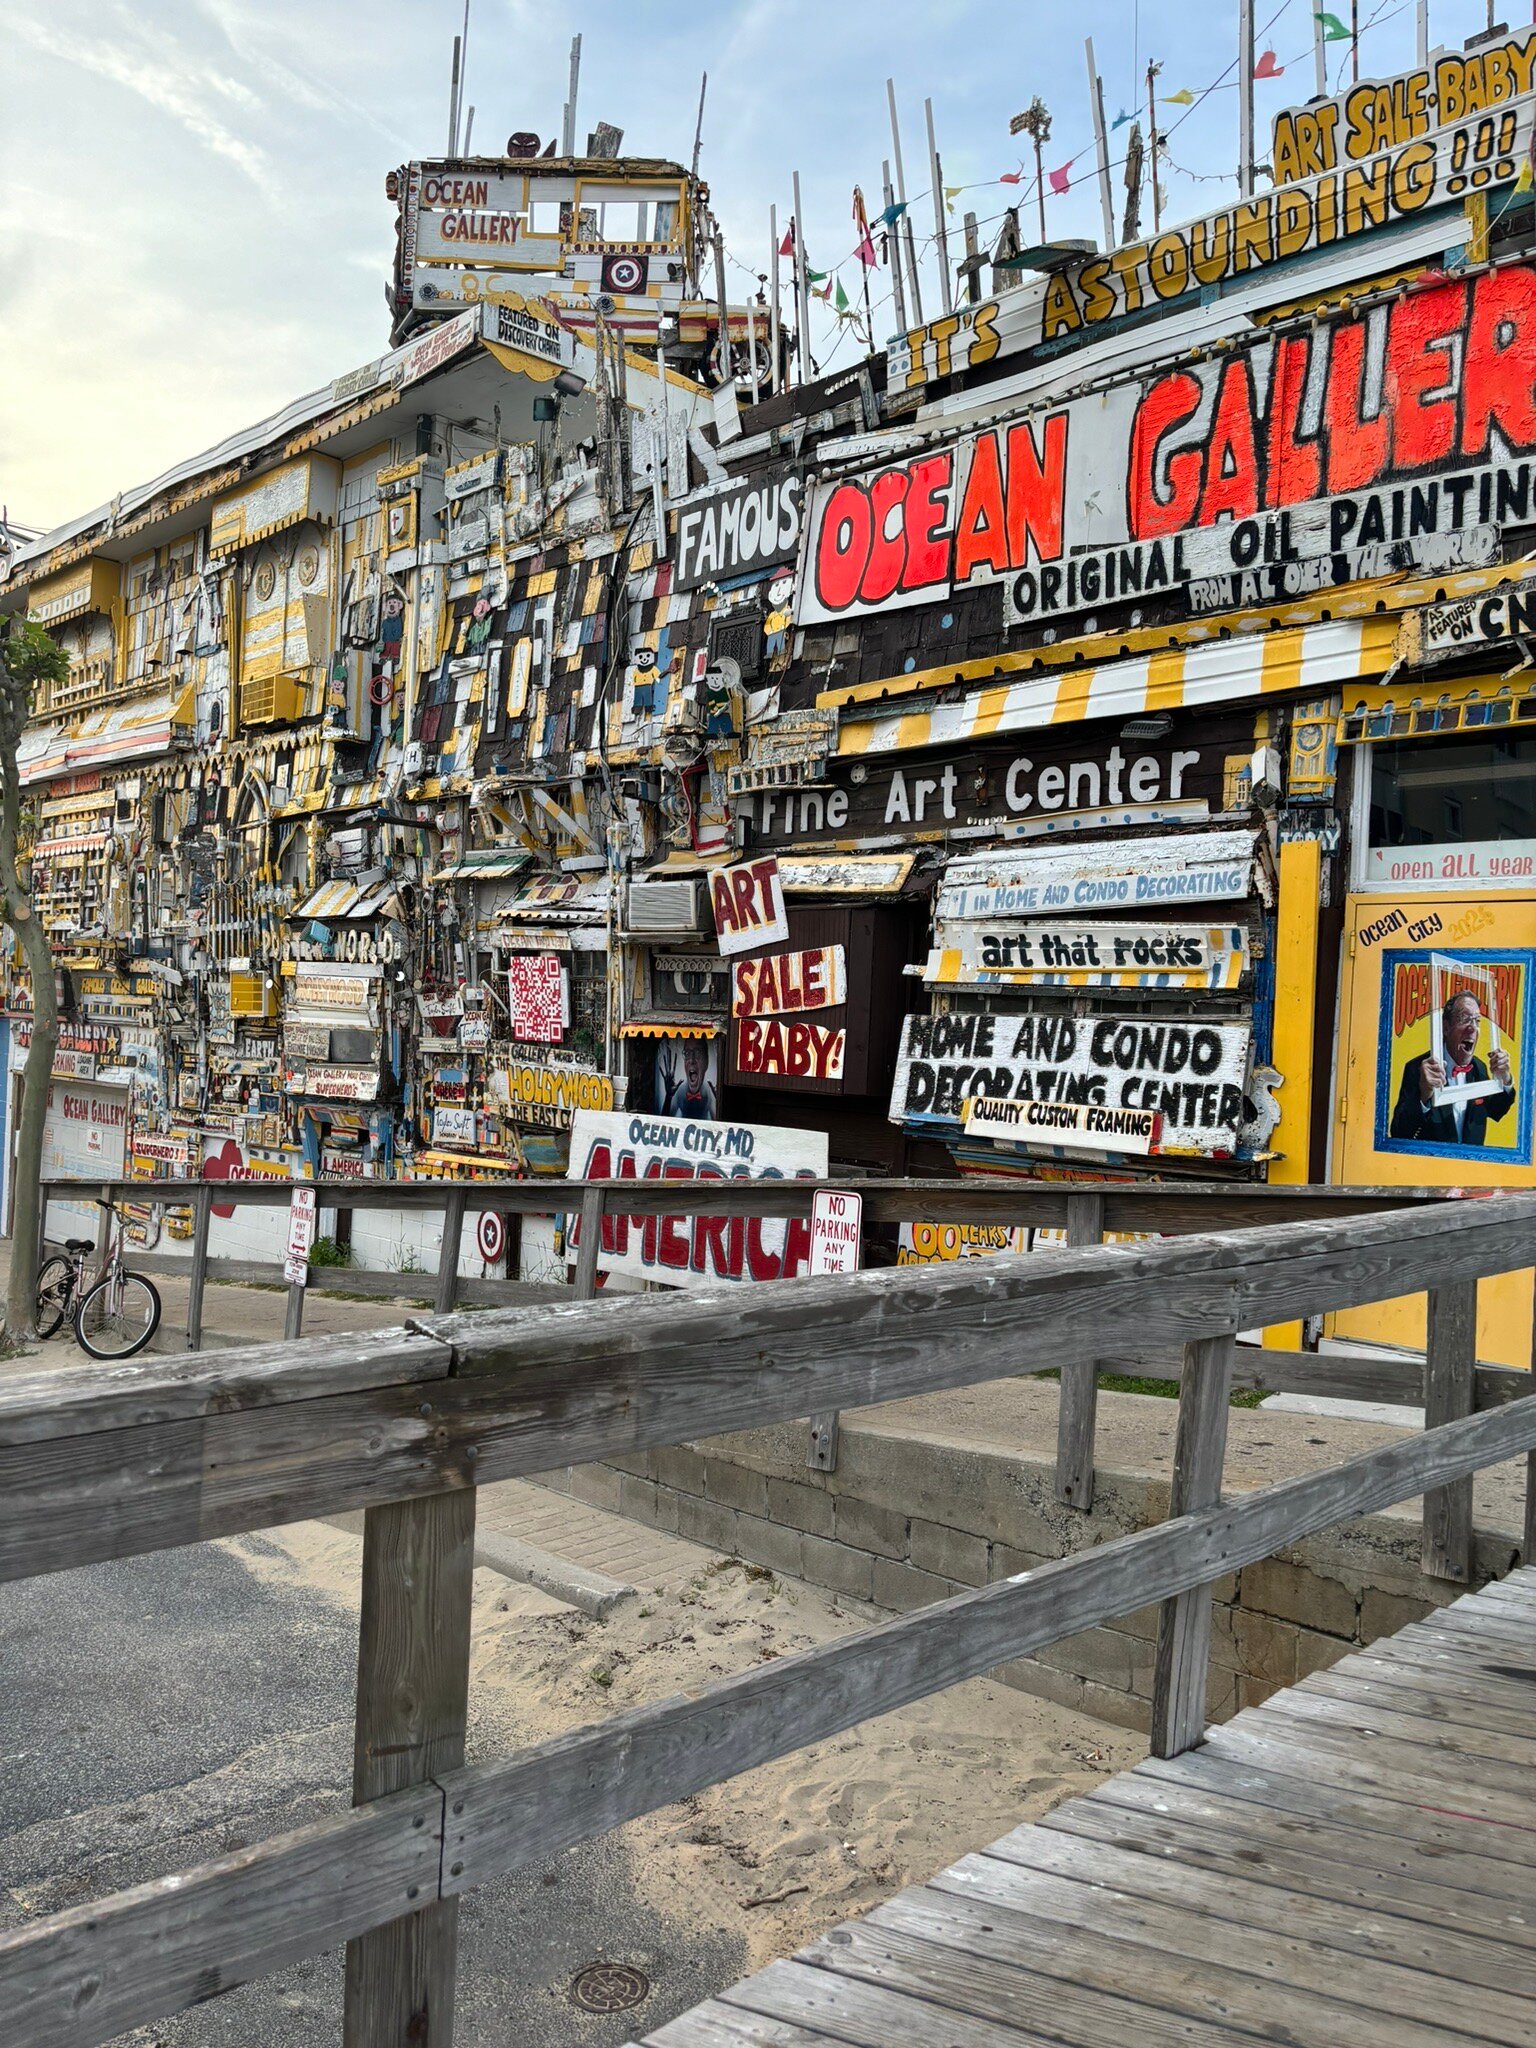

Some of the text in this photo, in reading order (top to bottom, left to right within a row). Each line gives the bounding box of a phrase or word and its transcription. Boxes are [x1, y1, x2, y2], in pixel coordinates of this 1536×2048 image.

[1273, 110, 1338, 186] ART
[424, 179, 488, 207] OCEAN
[440, 214, 522, 245] GALLERY
[498, 320, 537, 351] DISCOVERY
[499, 305, 560, 341] FEATURED ON
[906, 302, 1002, 388] IT'S
[678, 477, 800, 580] FAMOUS
[816, 411, 1069, 613] OCEAN
[1013, 464, 1536, 614] ORIGINAL OIL PAINTIN
[1189, 577, 1234, 611] FROM
[1284, 556, 1336, 594] OVER
[1347, 544, 1397, 580] THE
[1409, 526, 1495, 567] WORLD
[1428, 607, 1444, 624] AS
[1429, 601, 1477, 641] FEATURED
[1450, 615, 1473, 641] ON
[762, 746, 1201, 836] Fine Art Center
[1391, 853, 1533, 880] open all year
[712, 858, 778, 935] ART
[974, 895, 990, 911] IN
[994, 887, 1039, 909] HOME
[1042, 885, 1070, 905] AND
[1074, 880, 1128, 904] CONDO
[1136, 871, 1242, 898] DECORATING
[982, 933, 1204, 967] art that rocks
[735, 949, 826, 1017] SALE
[511, 1045, 551, 1064] GALLERY
[739, 1019, 844, 1079] BABY!
[907, 1014, 1223, 1076] HOME AND CONDO
[51, 1053, 76, 1073] ARKING
[507, 1065, 614, 1111] HOLLYWOOD
[905, 1061, 1243, 1131] DECORATING CENTER
[63, 1095, 88, 1120] OCEAN
[91, 1099, 126, 1127] GALLERY
[511, 1105, 528, 1120] THE
[532, 1106, 557, 1127] EAST
[972, 1097, 1151, 1137] QUALITY CUSTOM FRAMING
[629, 1119, 755, 1159] OCEAN CITY, MD
[331, 1157, 364, 1177] AMERICA
[291, 1205, 313, 1221] PARKING
[300, 1191, 308, 1205] NO
[828, 1197, 846, 1216] NO
[294, 1232, 305, 1241] TIME
[296, 1222, 306, 1230] ANY
[815, 1220, 857, 1243] PARKING
[823, 1257, 844, 1272] TIME
[824, 1242, 846, 1255] ANY
